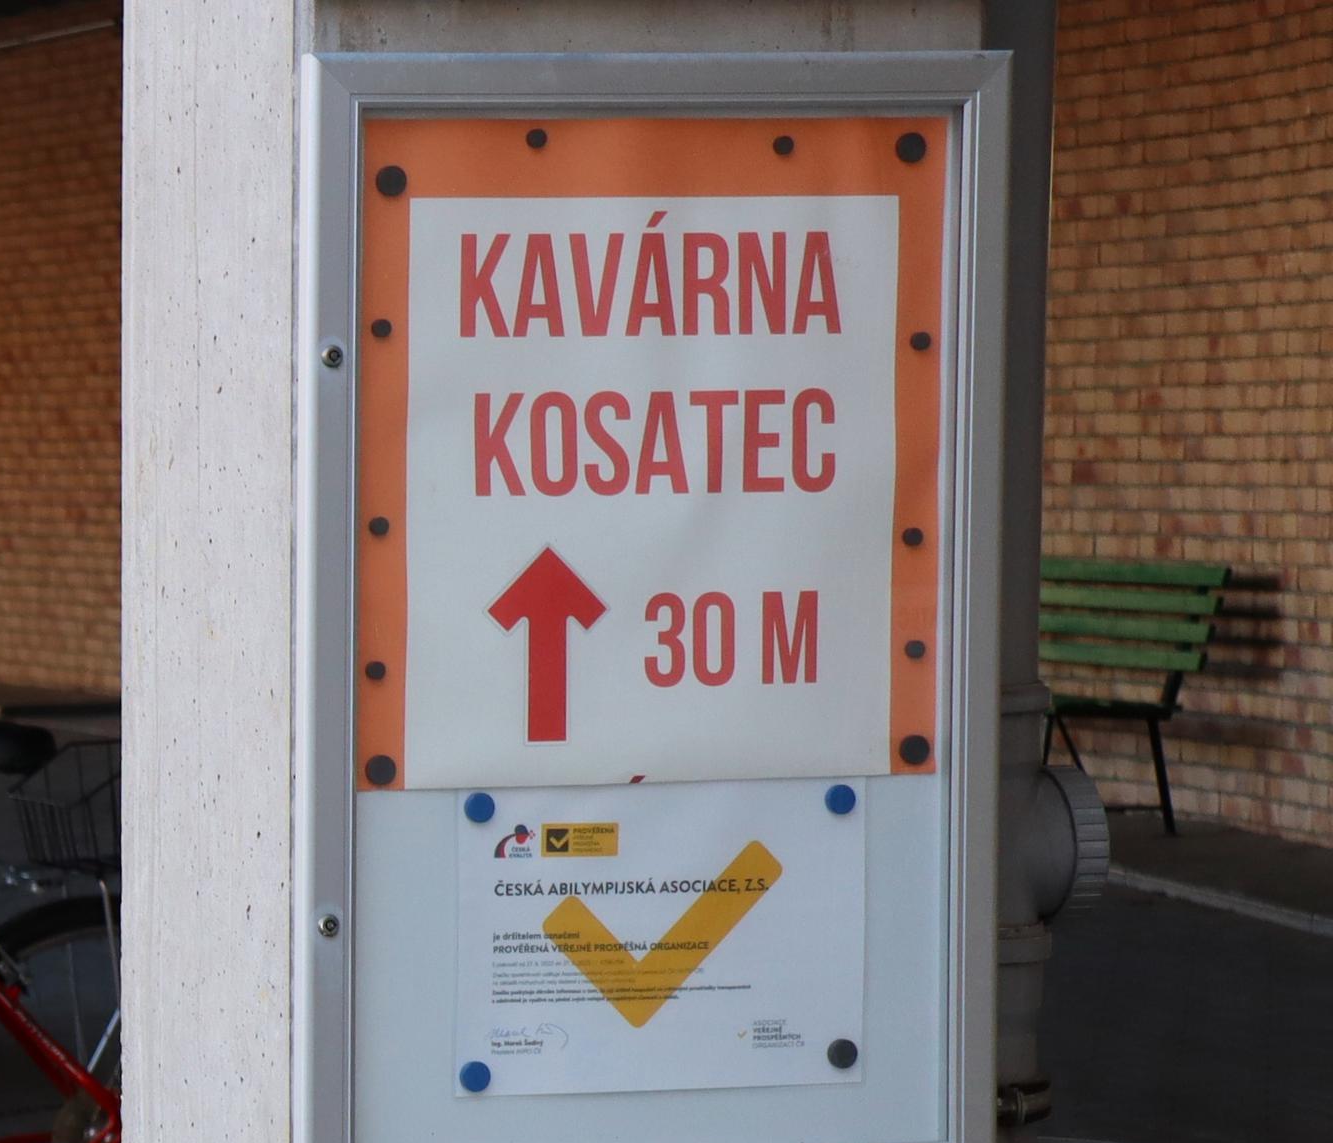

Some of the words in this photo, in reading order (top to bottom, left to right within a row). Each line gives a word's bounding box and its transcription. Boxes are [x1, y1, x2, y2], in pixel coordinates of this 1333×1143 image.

[459, 210, 842, 338] KAVÁRNA
[474, 388, 836, 497] KOSATEC
[643, 591, 735, 688] 30
[761, 590, 819, 684] M
[493, 879, 545, 897] ČESKÁ
[547, 878, 656, 896] ABILYMPIJSKÁ
[659, 878, 741, 895] ASOCIACE,
[744, 878, 770, 892] Z.S.
[493, 932, 501, 942] je
[502, 931, 542, 940] držitelem
[493, 943, 549, 954] PROVĚŘENÁ
[650, 940, 710, 951] ORGANIZACE
